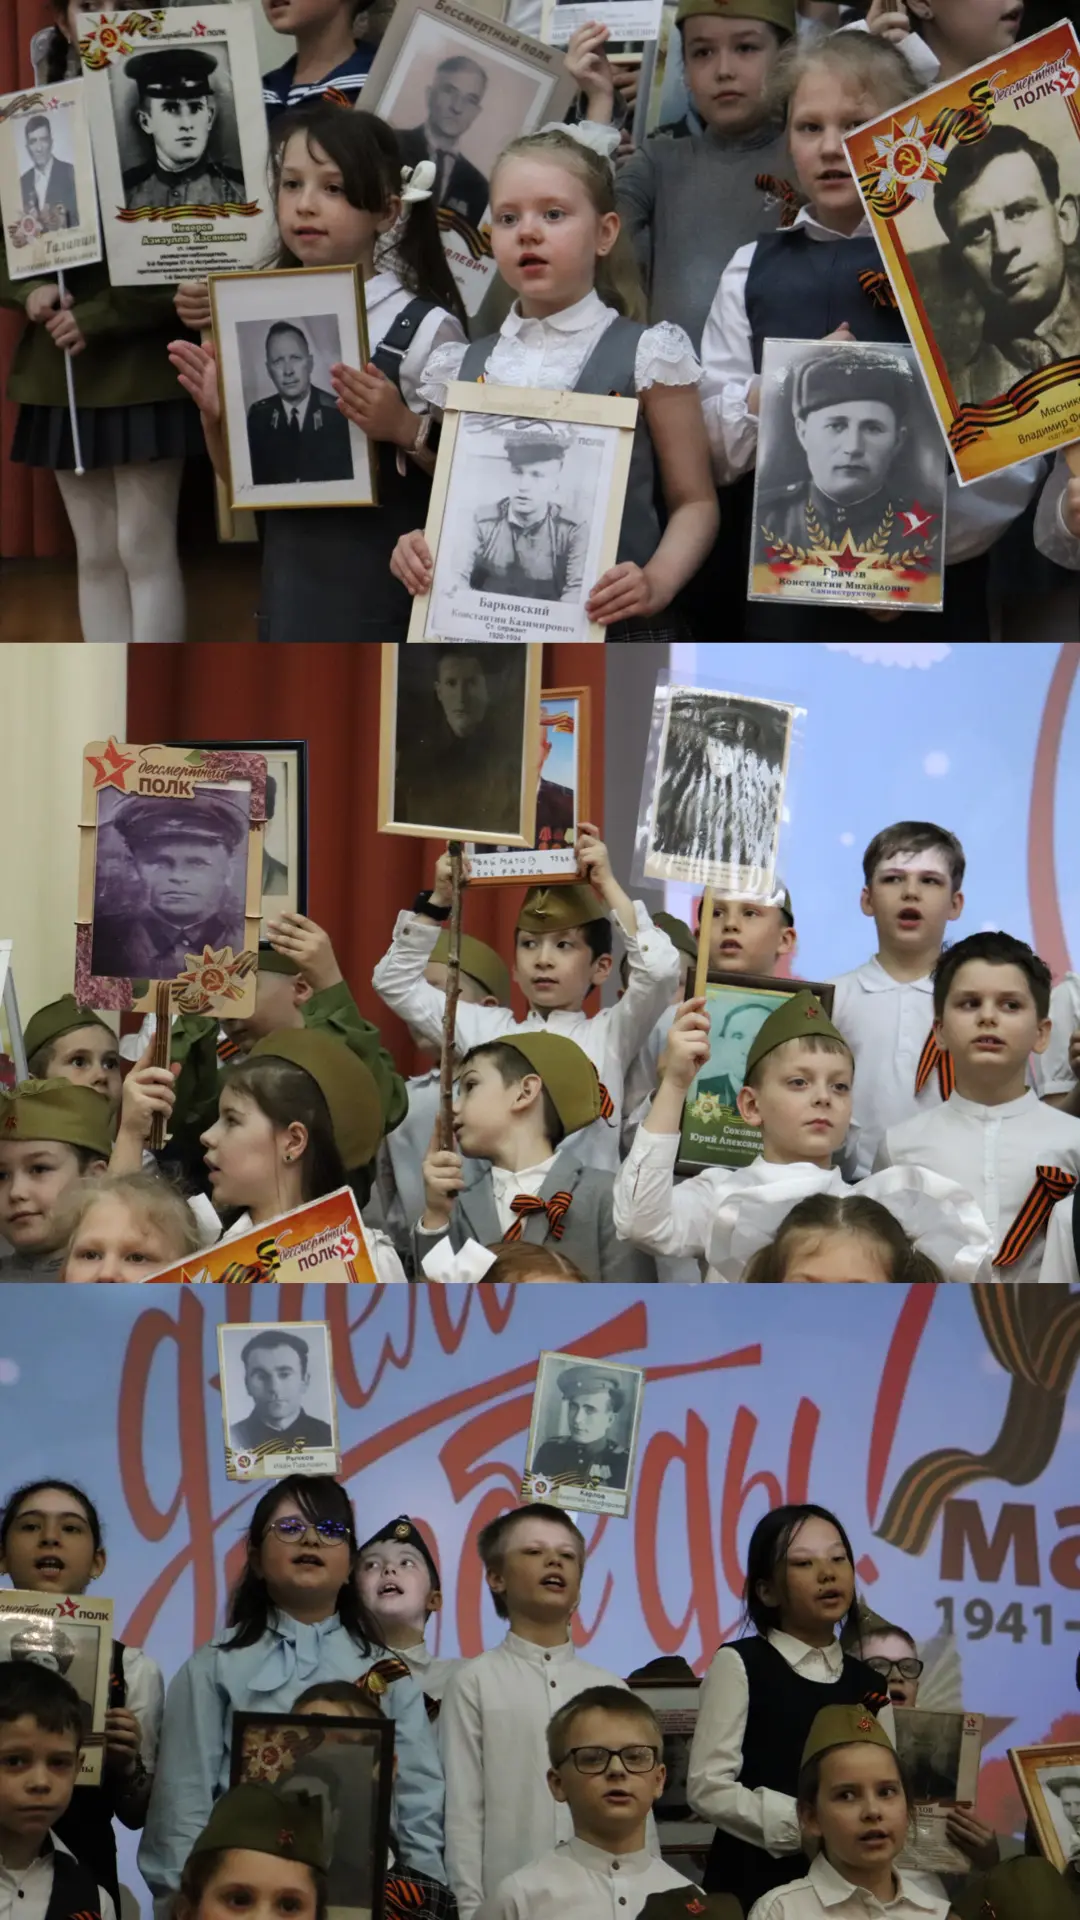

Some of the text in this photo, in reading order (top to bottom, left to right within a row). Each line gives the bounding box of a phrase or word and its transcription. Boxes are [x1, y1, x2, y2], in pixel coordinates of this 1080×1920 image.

[1013, 79, 1057, 111] ПОЛК
[1018, 419, 1069, 445] Владимир
[778, 577, 911, 592] Константин Михайлович
[479, 597, 550, 616] Барковский
[138, 777, 192, 795] ПОЛК
[689, 1132, 718, 1144] Юрий
[297, 1244, 339, 1272] ПОЛК
[79, 1610, 110, 1621] ПОЛК
